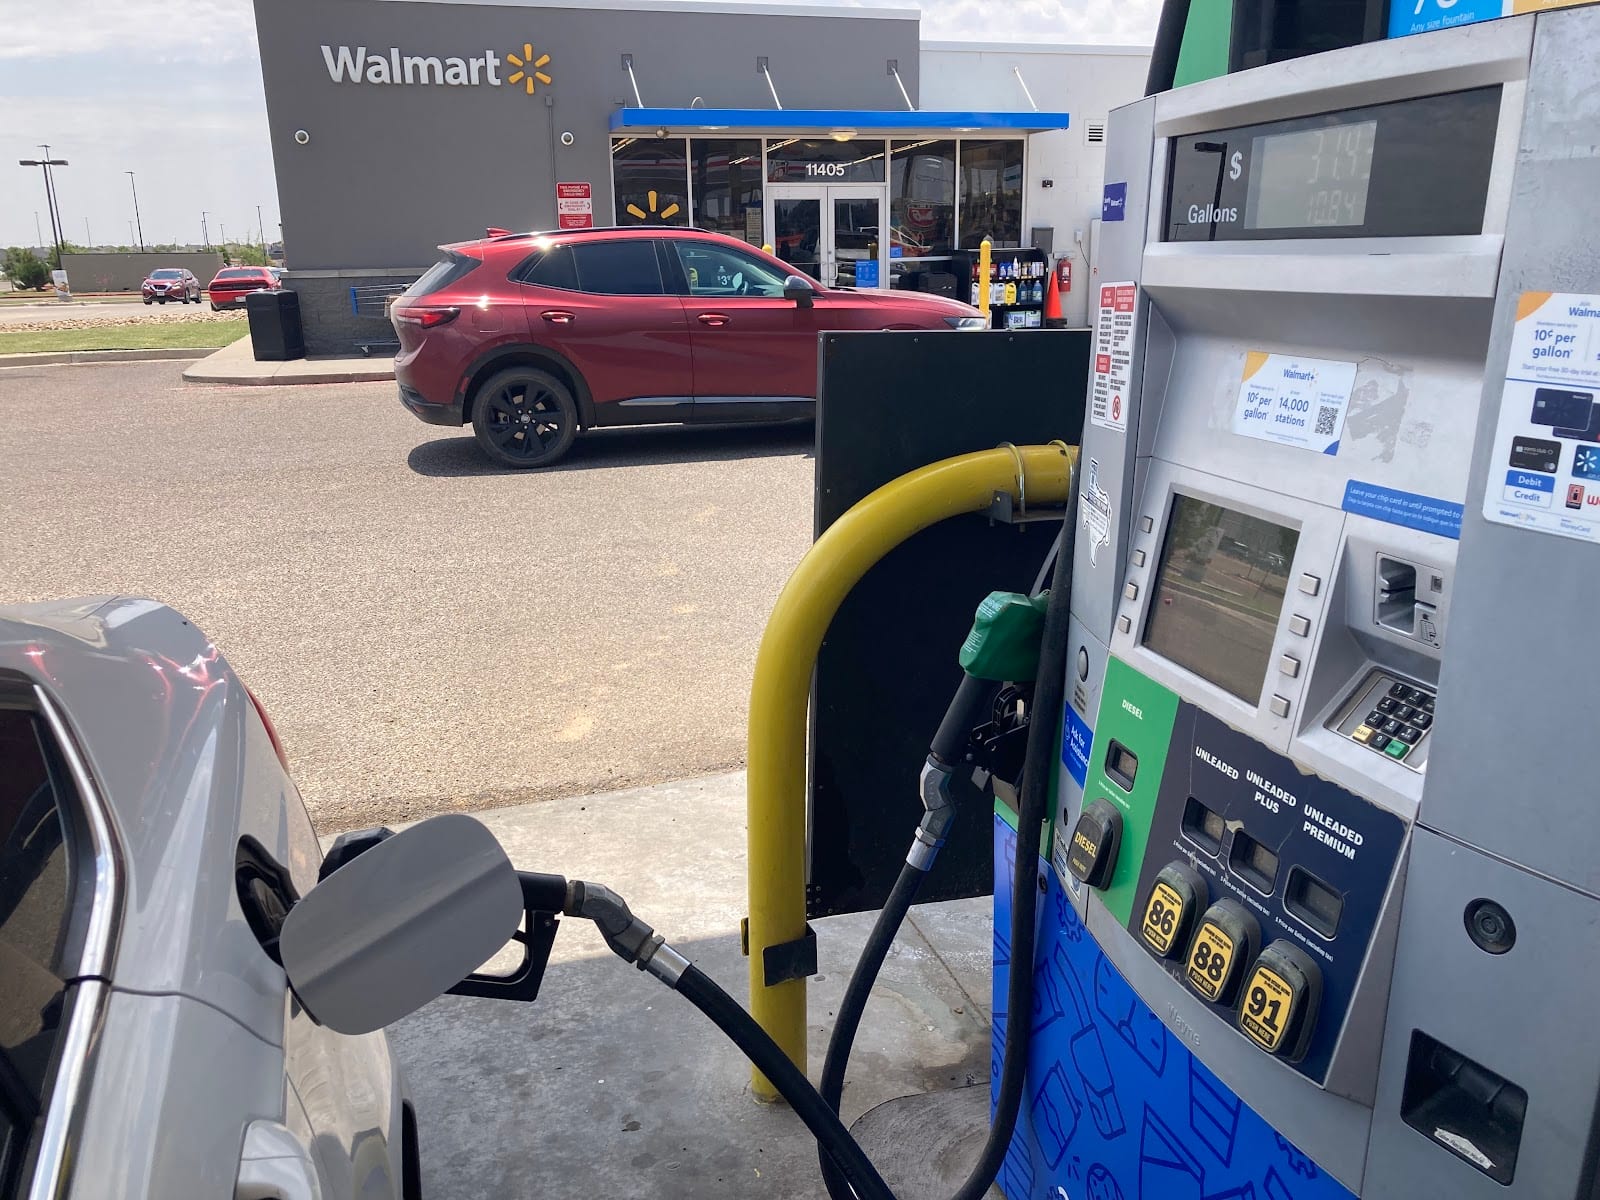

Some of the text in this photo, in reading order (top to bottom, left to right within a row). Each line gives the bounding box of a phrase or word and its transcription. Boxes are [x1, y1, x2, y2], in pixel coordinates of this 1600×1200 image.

[1410, 11, 1475, 34] Any size fountain
[320, 44, 502, 86] Walmart
[805, 163, 845, 176] 11405
[1229, 150, 1243, 181] $
[1188, 203, 1238, 224] Gallons
[1535, 329, 1576, 345] 10¢ per
[1258, 397, 1272, 407] per
[1279, 396, 1309, 412] 14,000
[1275, 413, 1305, 427] stations
[1518, 475, 1543, 487] Debit
[1350, 486, 1461, 519] Leave your chip card in until prompted to
[1514, 490, 1541, 502] Credit
[1122, 699, 1143, 720] DIESEL
[1071, 725, 1079, 741] Ask
[1195, 746, 1240, 780] UNLEADED
[1246, 769, 1297, 807] UNLEADED
[1254, 791, 1280, 814] PLUS
[1304, 804, 1364, 846] UNLEADED
[1074, 831, 1097, 859] DIESEL
[1303, 821, 1356, 861] PREMIUM
[1149, 899, 1176, 936] 86
[1278, 918, 1288, 930] Price
[1294, 929, 1306, 942] Gallon
[1194, 941, 1226, 982] 88
[1248, 986, 1282, 1033] 91
